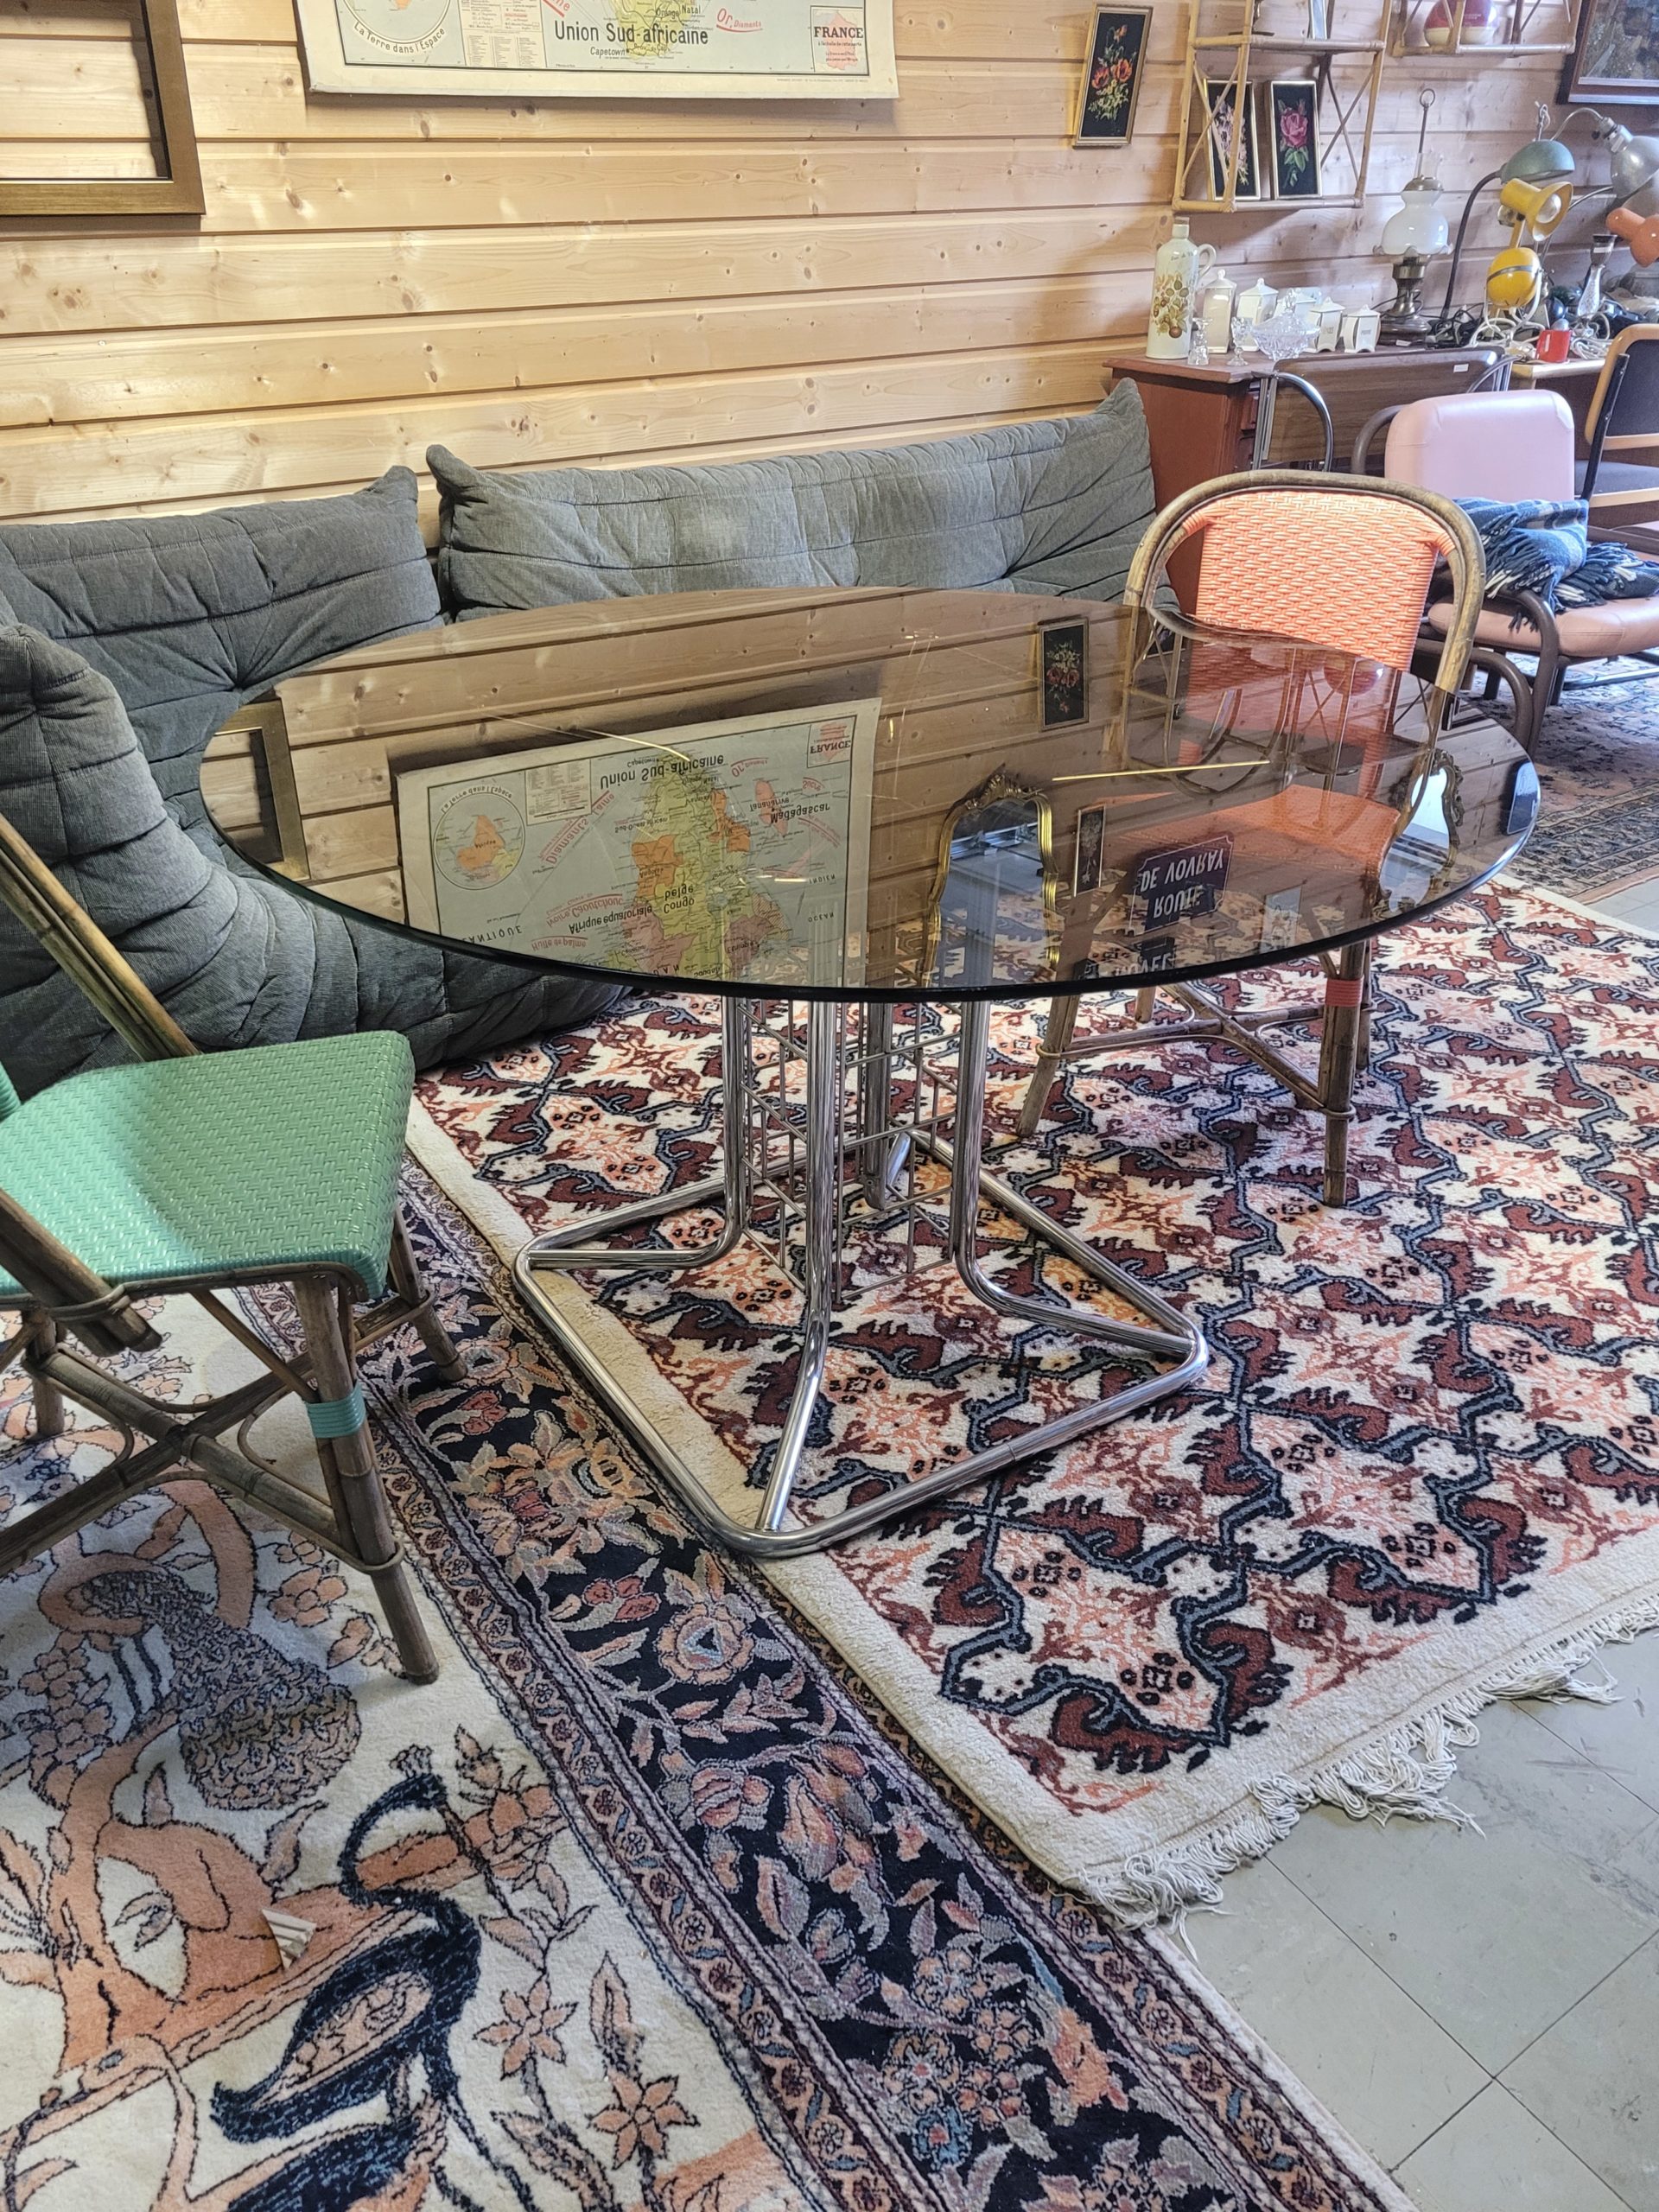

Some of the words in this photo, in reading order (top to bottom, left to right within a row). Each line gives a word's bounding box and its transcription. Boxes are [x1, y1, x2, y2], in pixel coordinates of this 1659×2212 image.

[353, 22, 365, 33] La
[365, 30, 391, 53] Terre
[393, 44, 416, 54] dans
[416, 27, 446, 54] l'Espace
[555, 21, 599, 41] Union
[607, 22, 709, 44] Sud-africaine
[814, 26, 863, 38] FRANCE
[590, 47, 626, 59] Capetown
